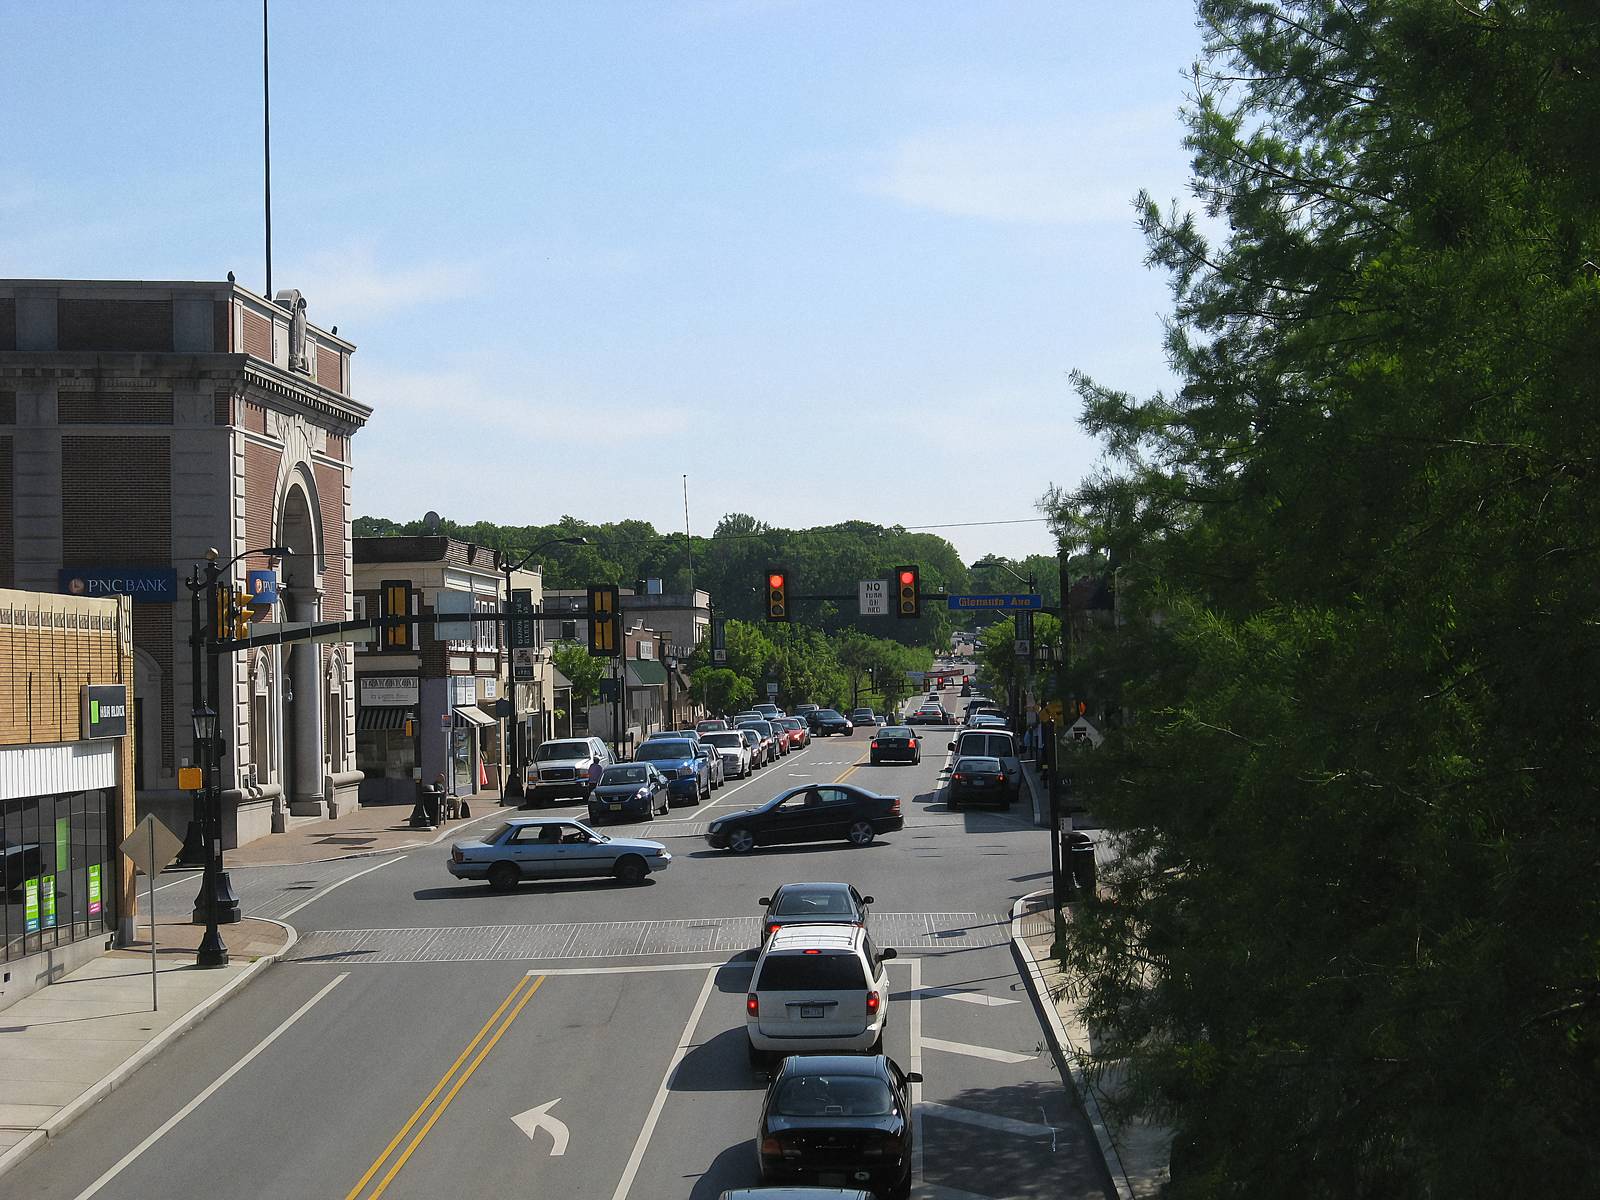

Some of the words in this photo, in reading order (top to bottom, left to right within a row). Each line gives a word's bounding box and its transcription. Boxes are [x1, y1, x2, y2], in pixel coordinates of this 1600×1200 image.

[88, 579, 123, 592] PNC
[126, 579, 167, 592] BANK
[866, 583, 881, 592] NO
[1012, 596, 1030, 606] Ave
[111, 705, 125, 717] BLOCK
